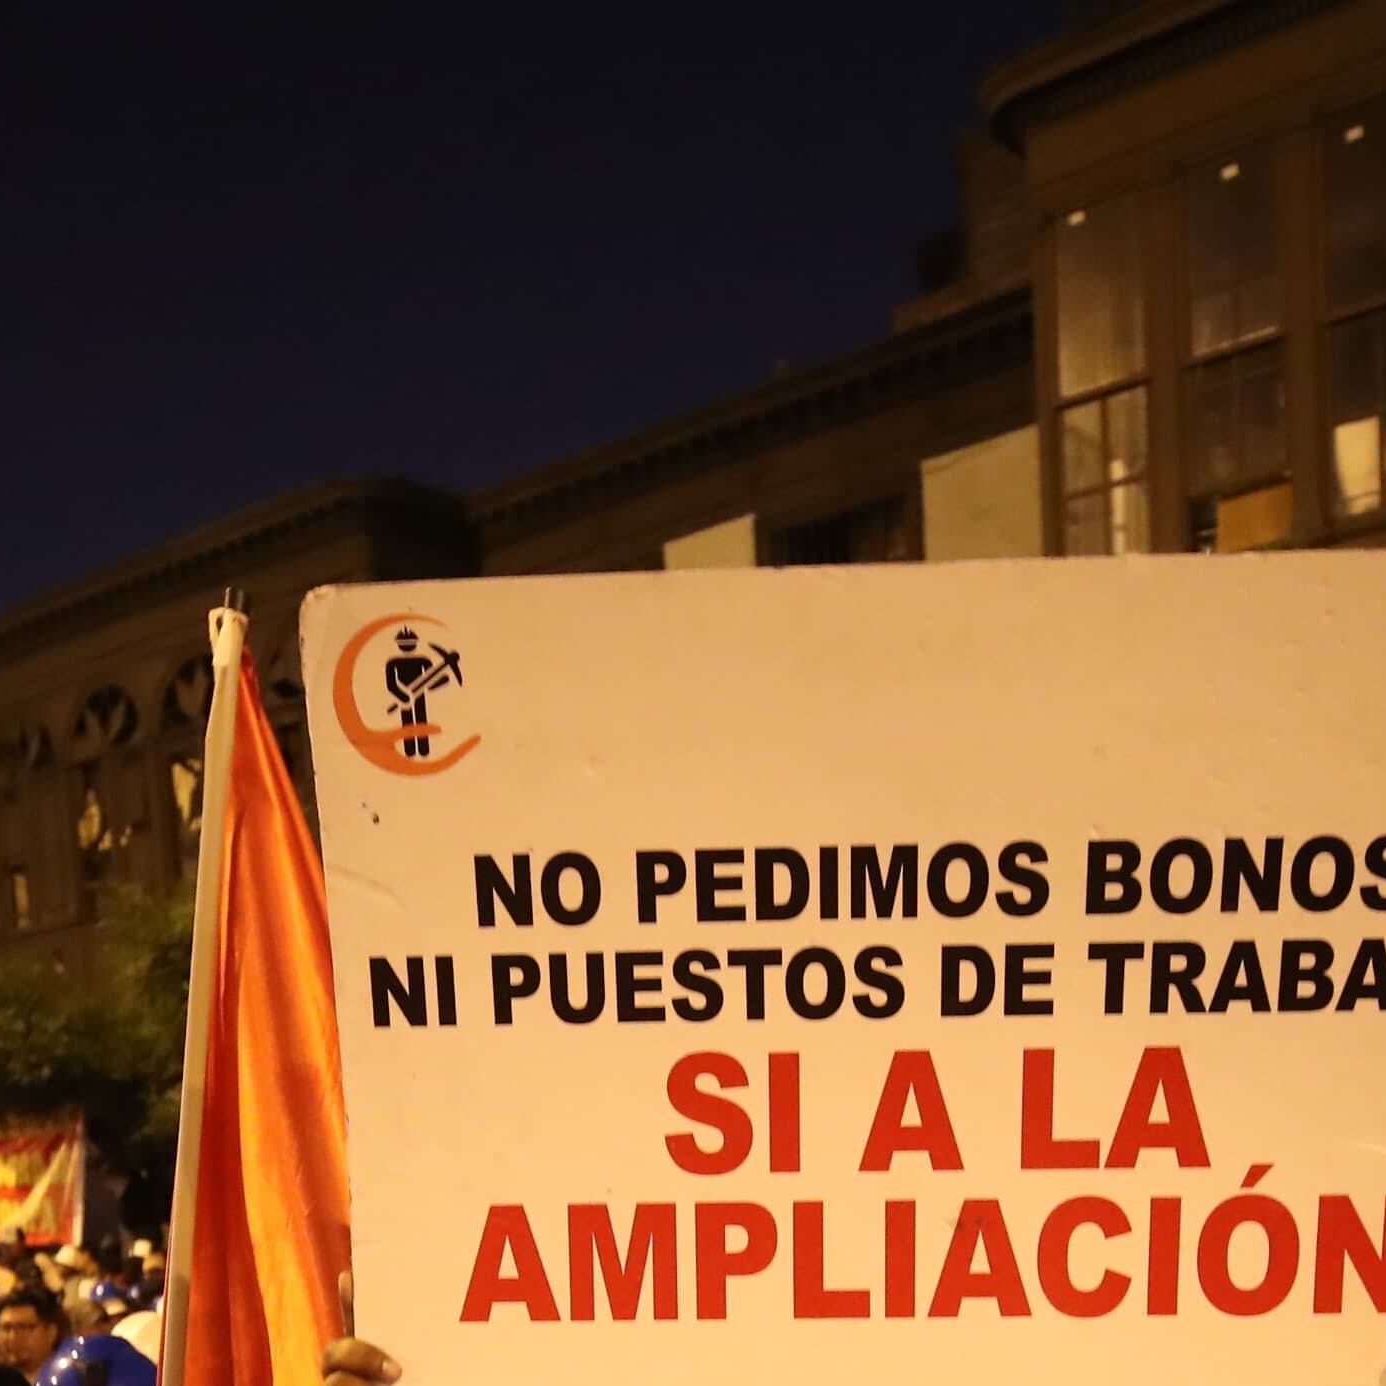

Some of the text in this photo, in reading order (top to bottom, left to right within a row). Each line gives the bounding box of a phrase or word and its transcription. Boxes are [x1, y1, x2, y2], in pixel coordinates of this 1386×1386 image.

[473, 852, 602, 928] NO
[635, 841, 1050, 924] PEDIMOS
[368, 955, 458, 1028] NI
[490, 944, 906, 1026] PUESTOS
[940, 943, 1055, 1018] DE
[664, 1046, 1212, 1176] SI A LA
